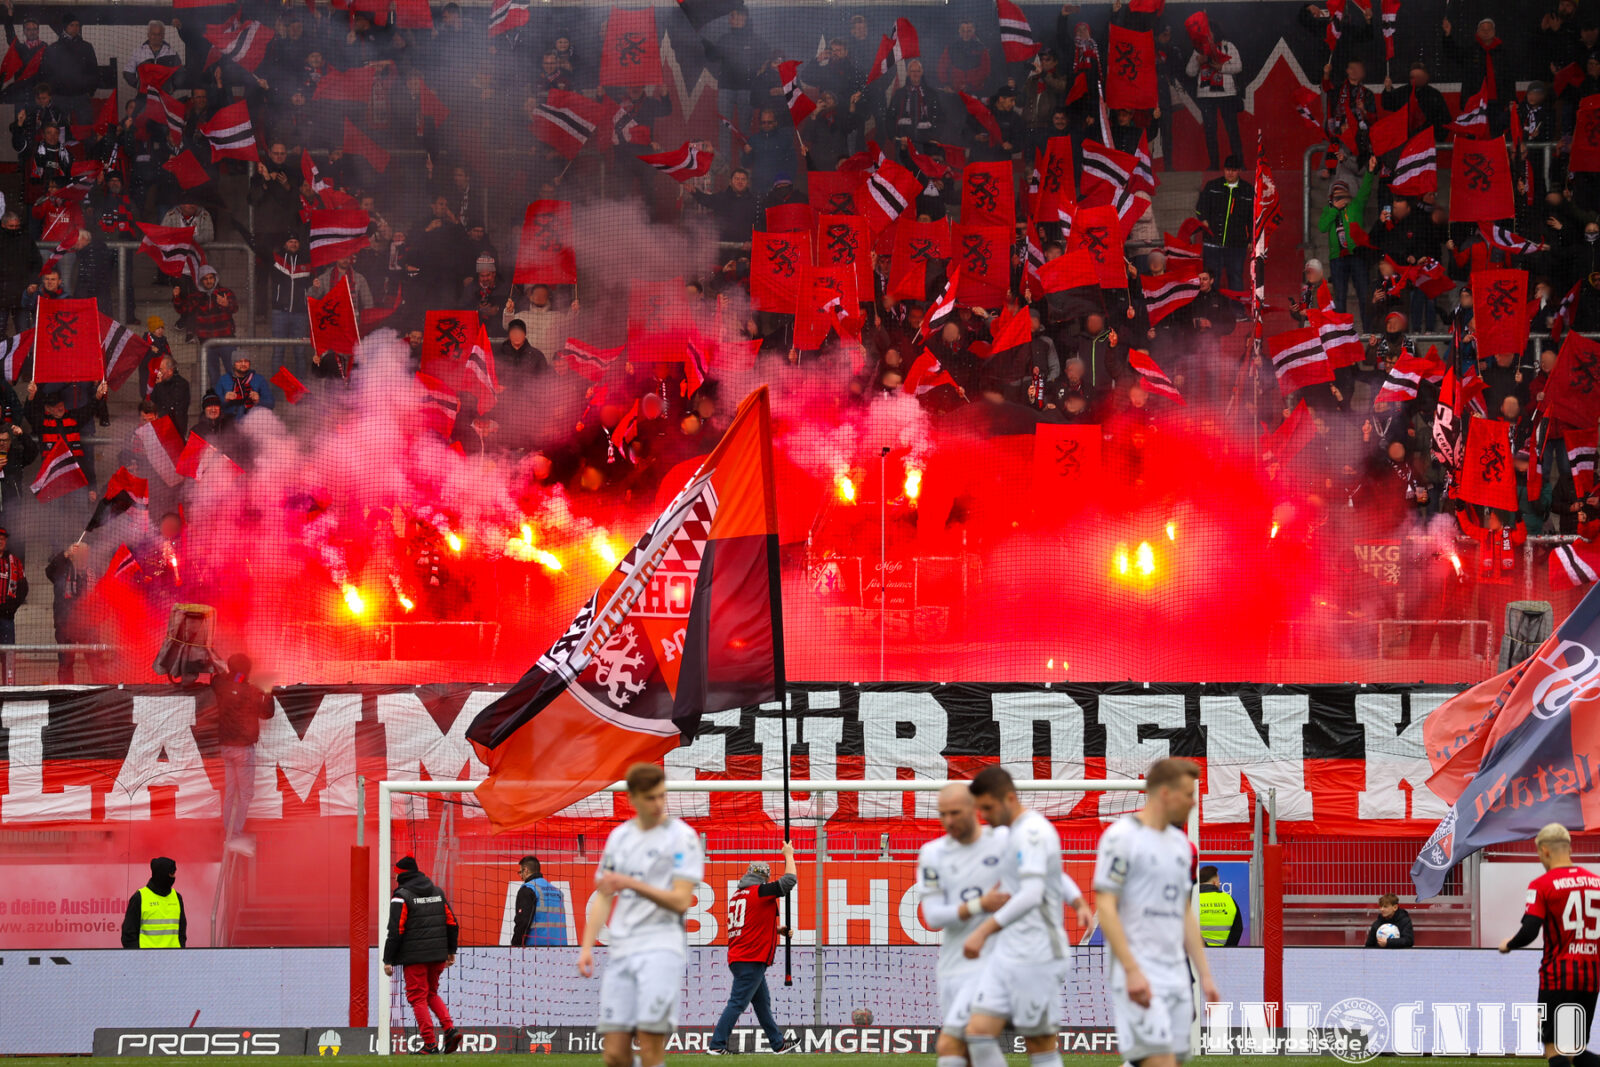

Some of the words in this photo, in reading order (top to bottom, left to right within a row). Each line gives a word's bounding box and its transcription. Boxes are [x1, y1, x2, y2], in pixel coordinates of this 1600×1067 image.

[663, 690, 949, 827] FÜR
[991, 693, 1313, 824] DEN
[11, 899, 57, 915] deine
[60, 898, 129, 915] Ausbildu
[1562, 889, 1600, 940] 45
